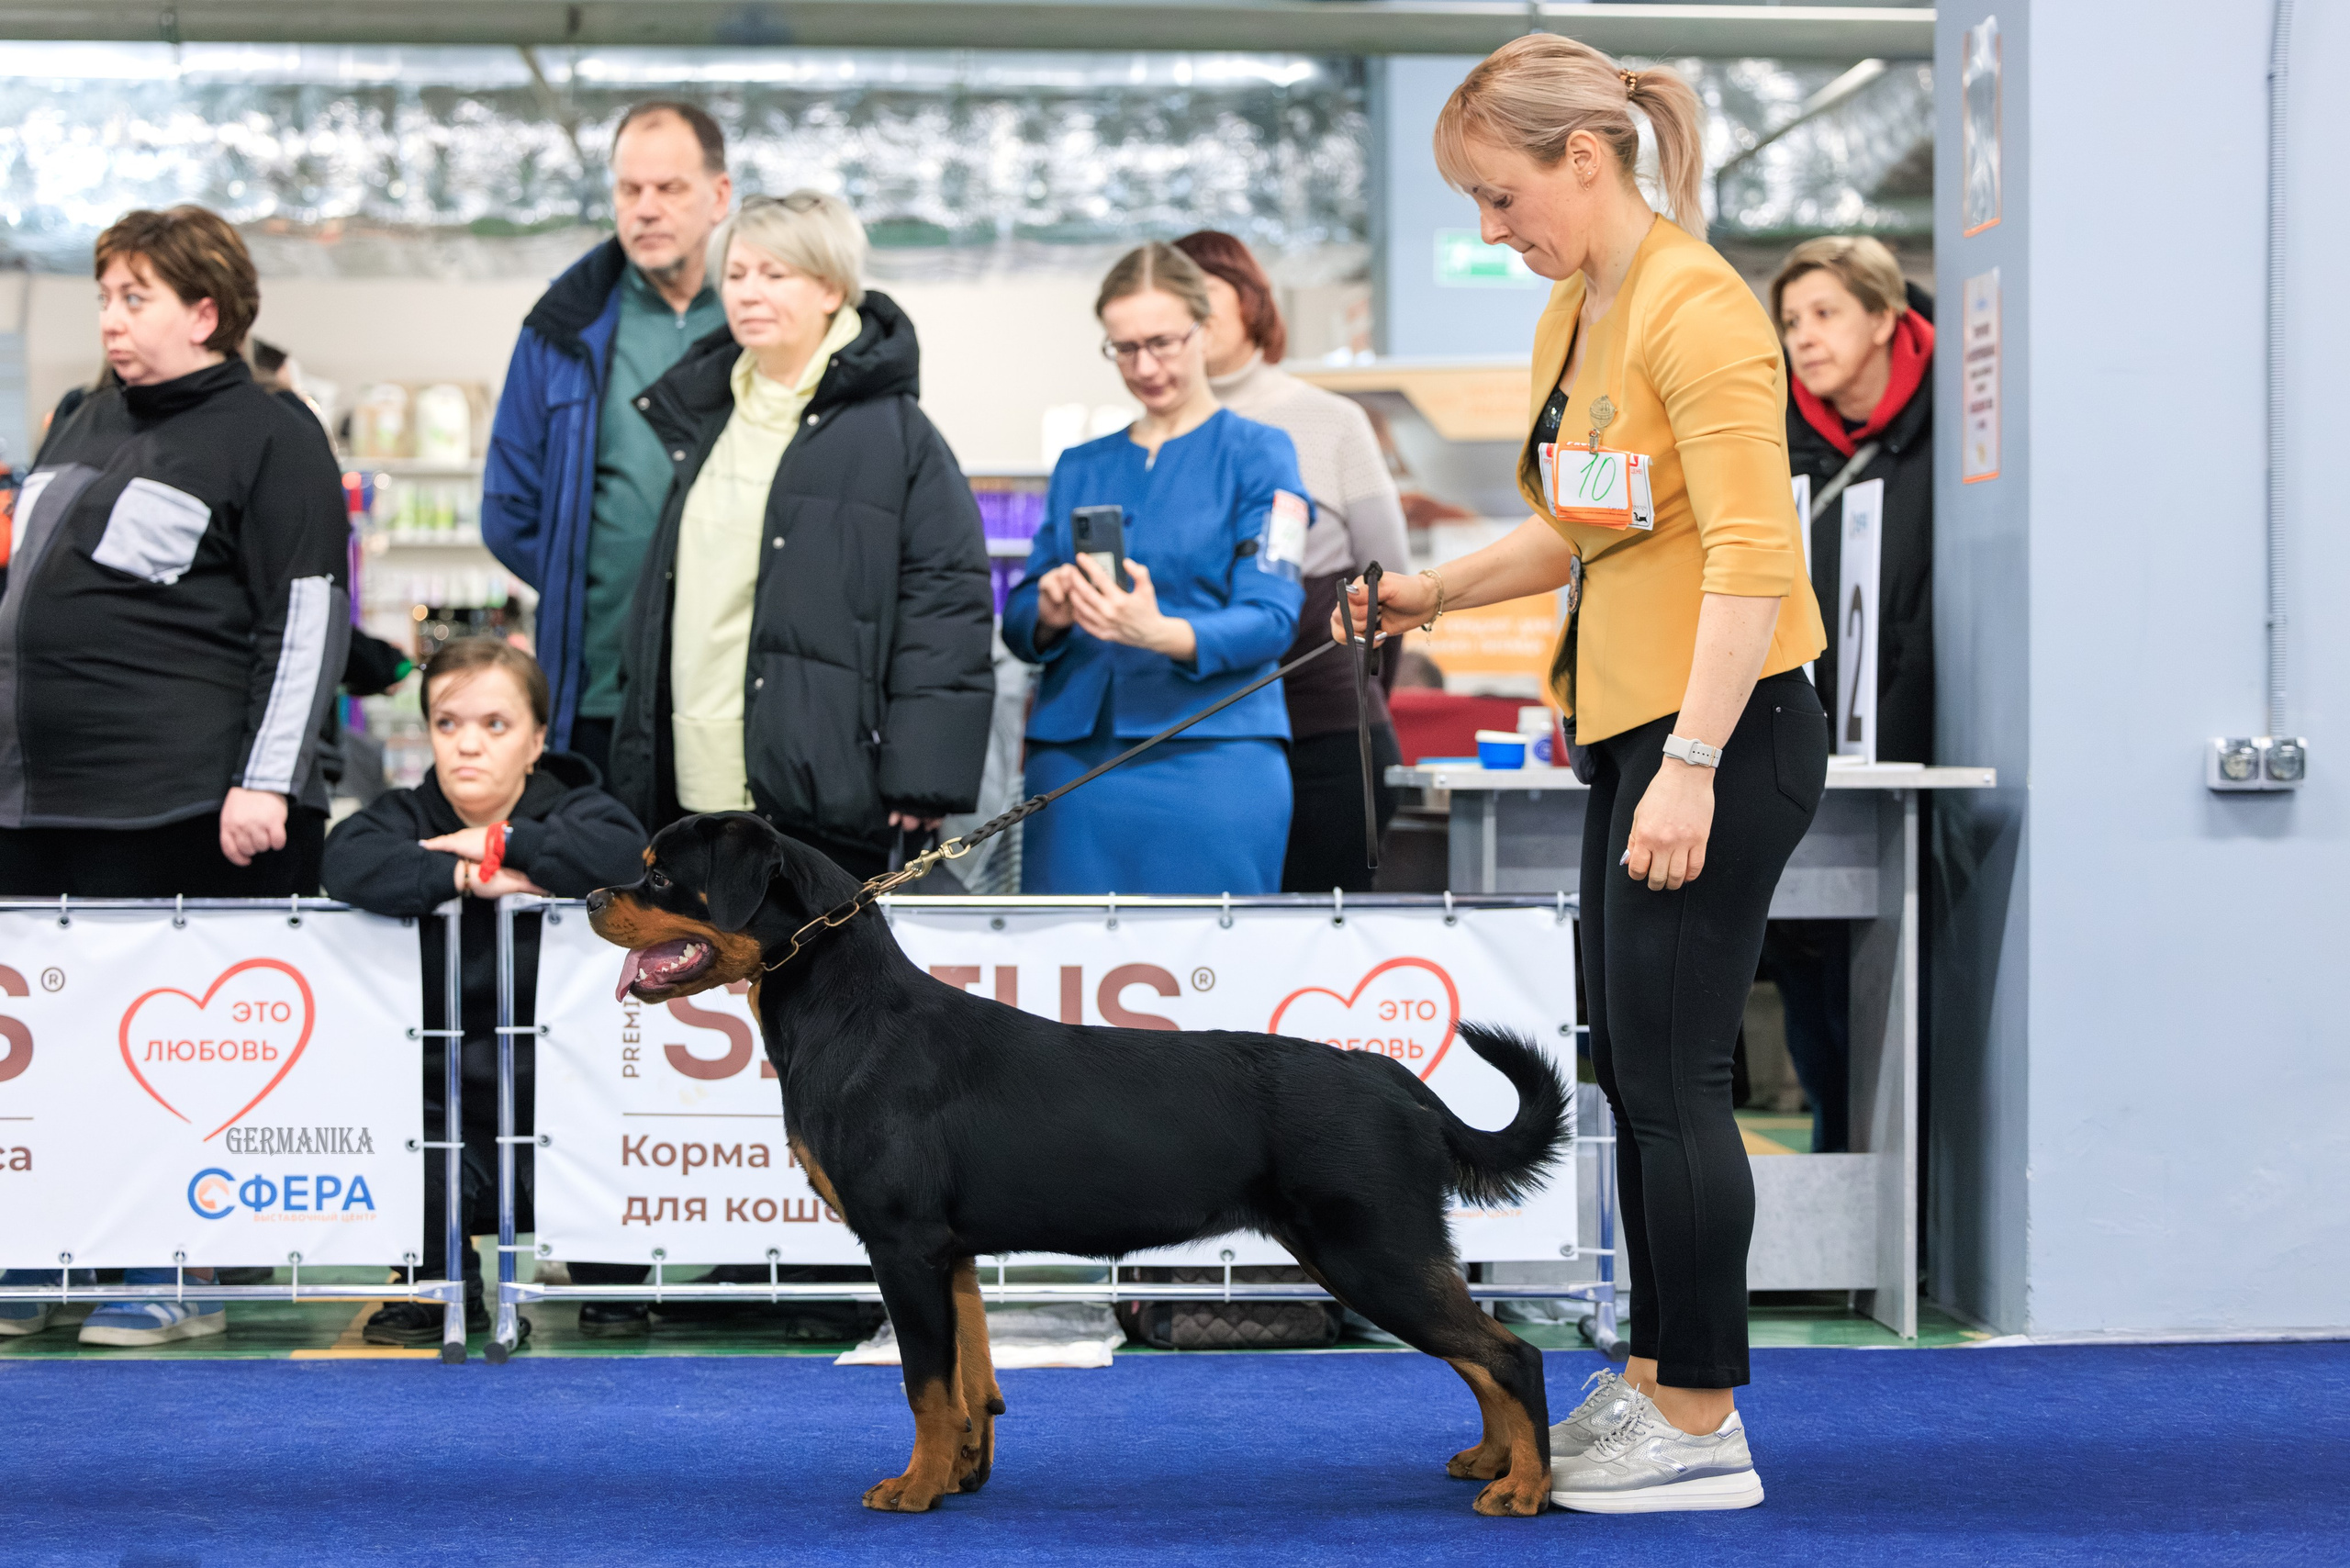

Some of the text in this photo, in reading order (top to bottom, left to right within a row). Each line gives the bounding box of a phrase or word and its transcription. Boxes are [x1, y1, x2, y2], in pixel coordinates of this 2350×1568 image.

[1578, 454, 1617, 501] 10
[1846, 583, 1863, 742] 2
[232, 1001, 291, 1023] ЭТО
[1379, 1000, 1437, 1021] ЭТО
[144, 1040, 278, 1061] ЛЮБОВЬ
[226, 1126, 375, 1156] GERMANIKA
[622, 1134, 770, 1175] Корма
[187, 1168, 375, 1219] СФЕРА
[622, 1196, 707, 1226] для
